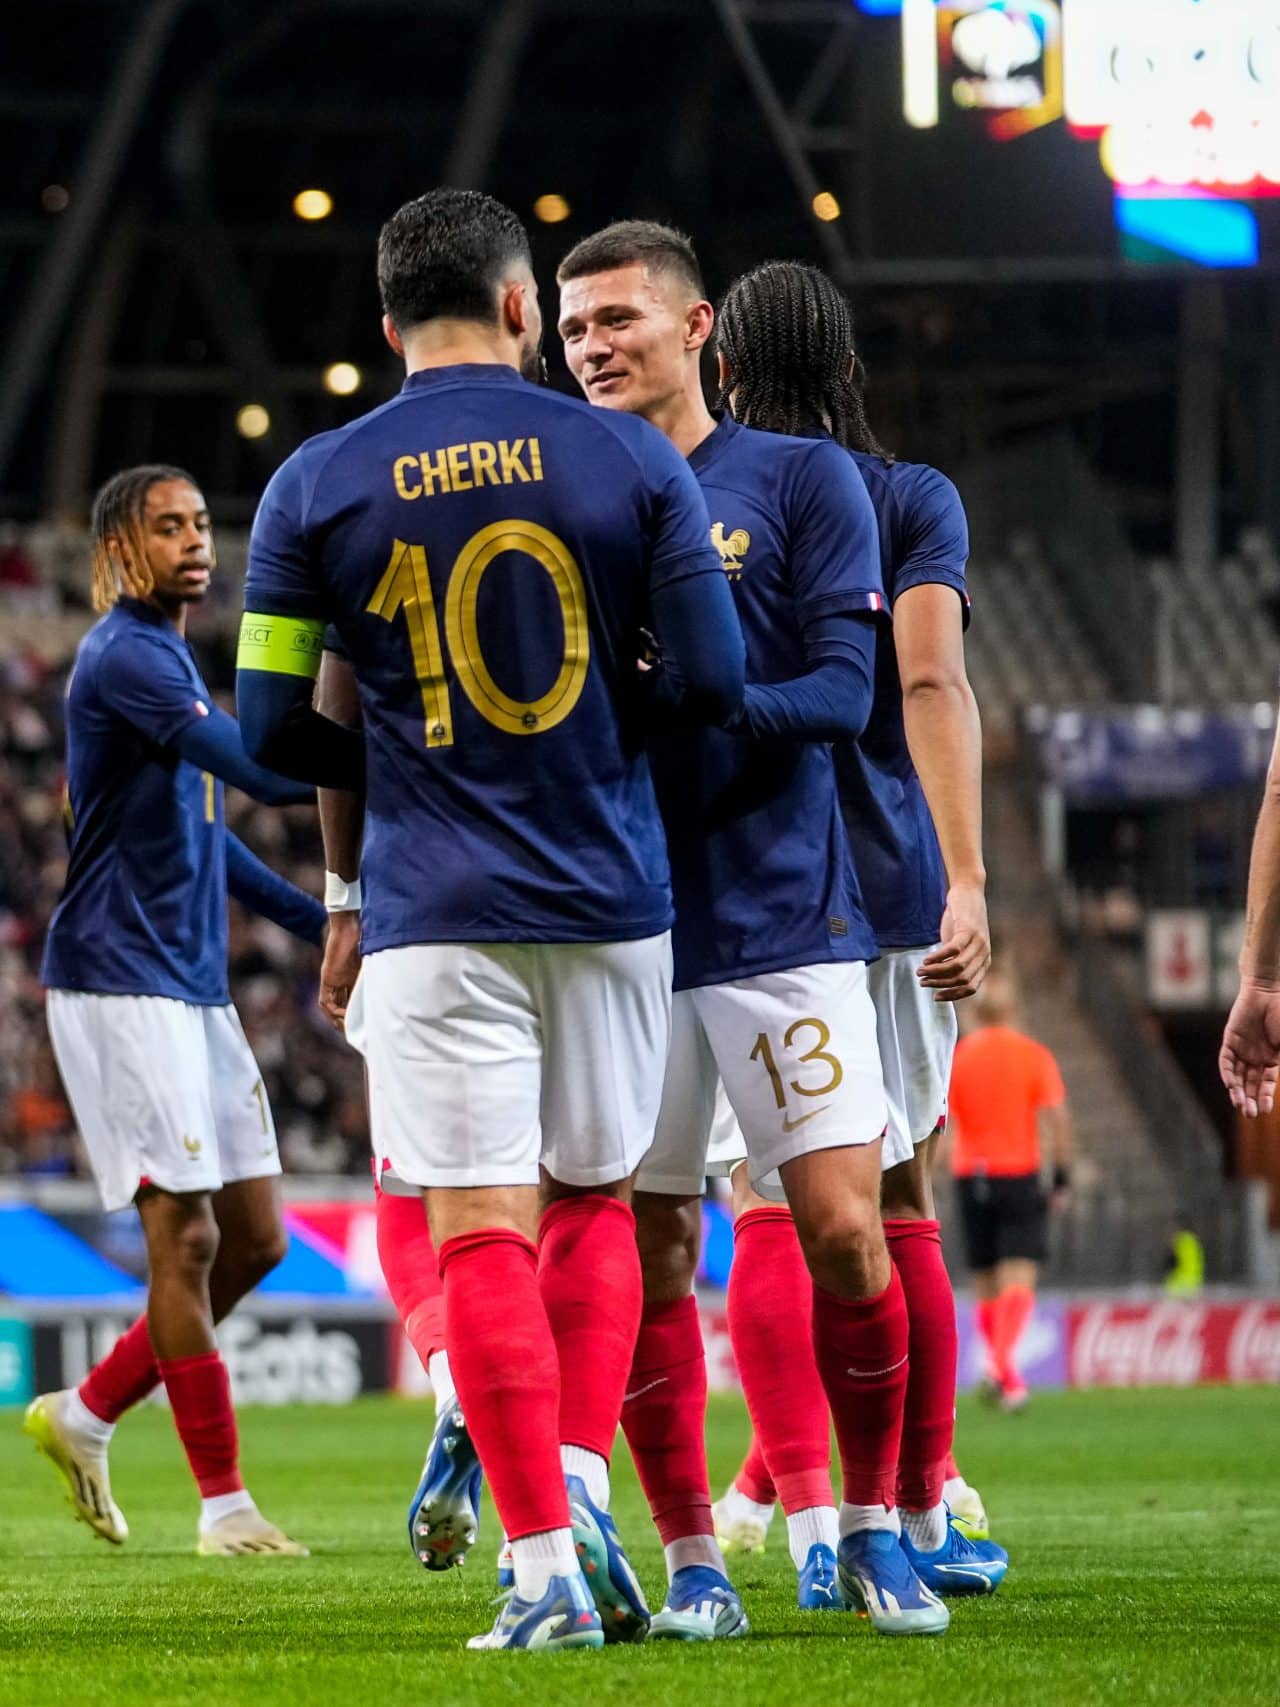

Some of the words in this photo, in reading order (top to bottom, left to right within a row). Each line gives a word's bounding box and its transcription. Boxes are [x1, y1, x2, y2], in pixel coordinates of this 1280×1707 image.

[393, 437, 545, 501] CHERKI
[366, 519, 590, 749] 10
[749, 1017, 844, 1110] 13
